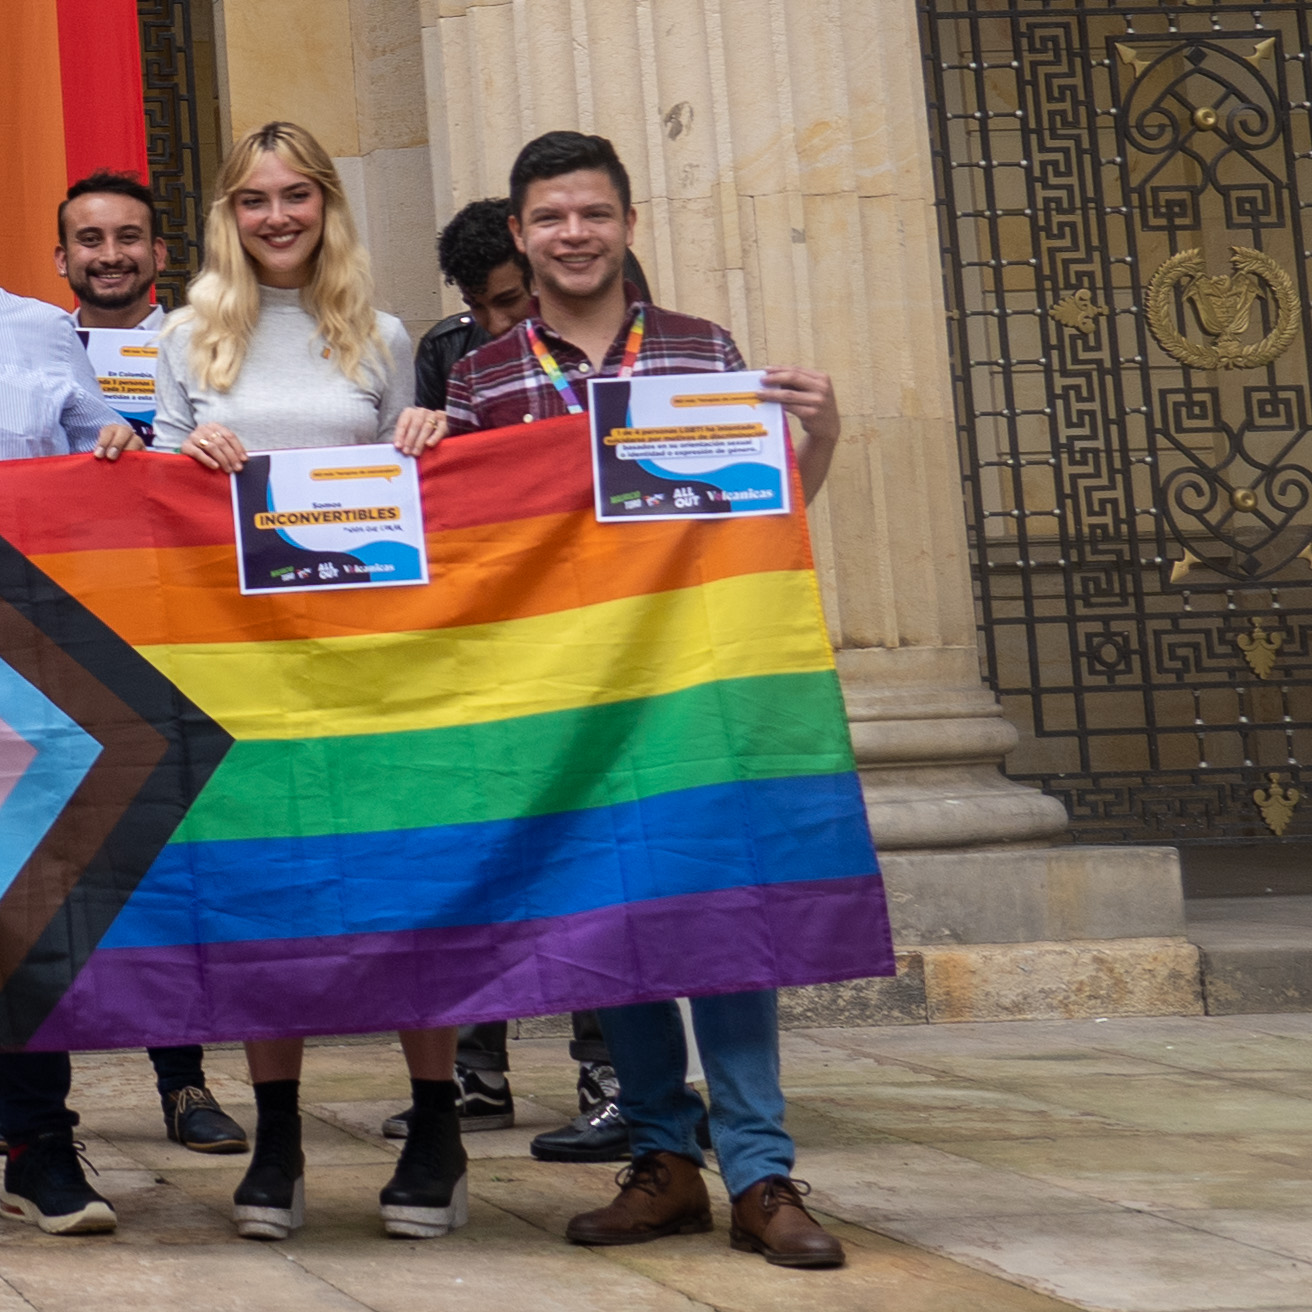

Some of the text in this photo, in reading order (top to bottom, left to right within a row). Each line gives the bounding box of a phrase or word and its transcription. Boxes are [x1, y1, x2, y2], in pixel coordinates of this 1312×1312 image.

[673, 487, 694, 498] ALL
[674, 495, 700, 508] OUT
[260, 507, 396, 526] INCONVERTIBLES
